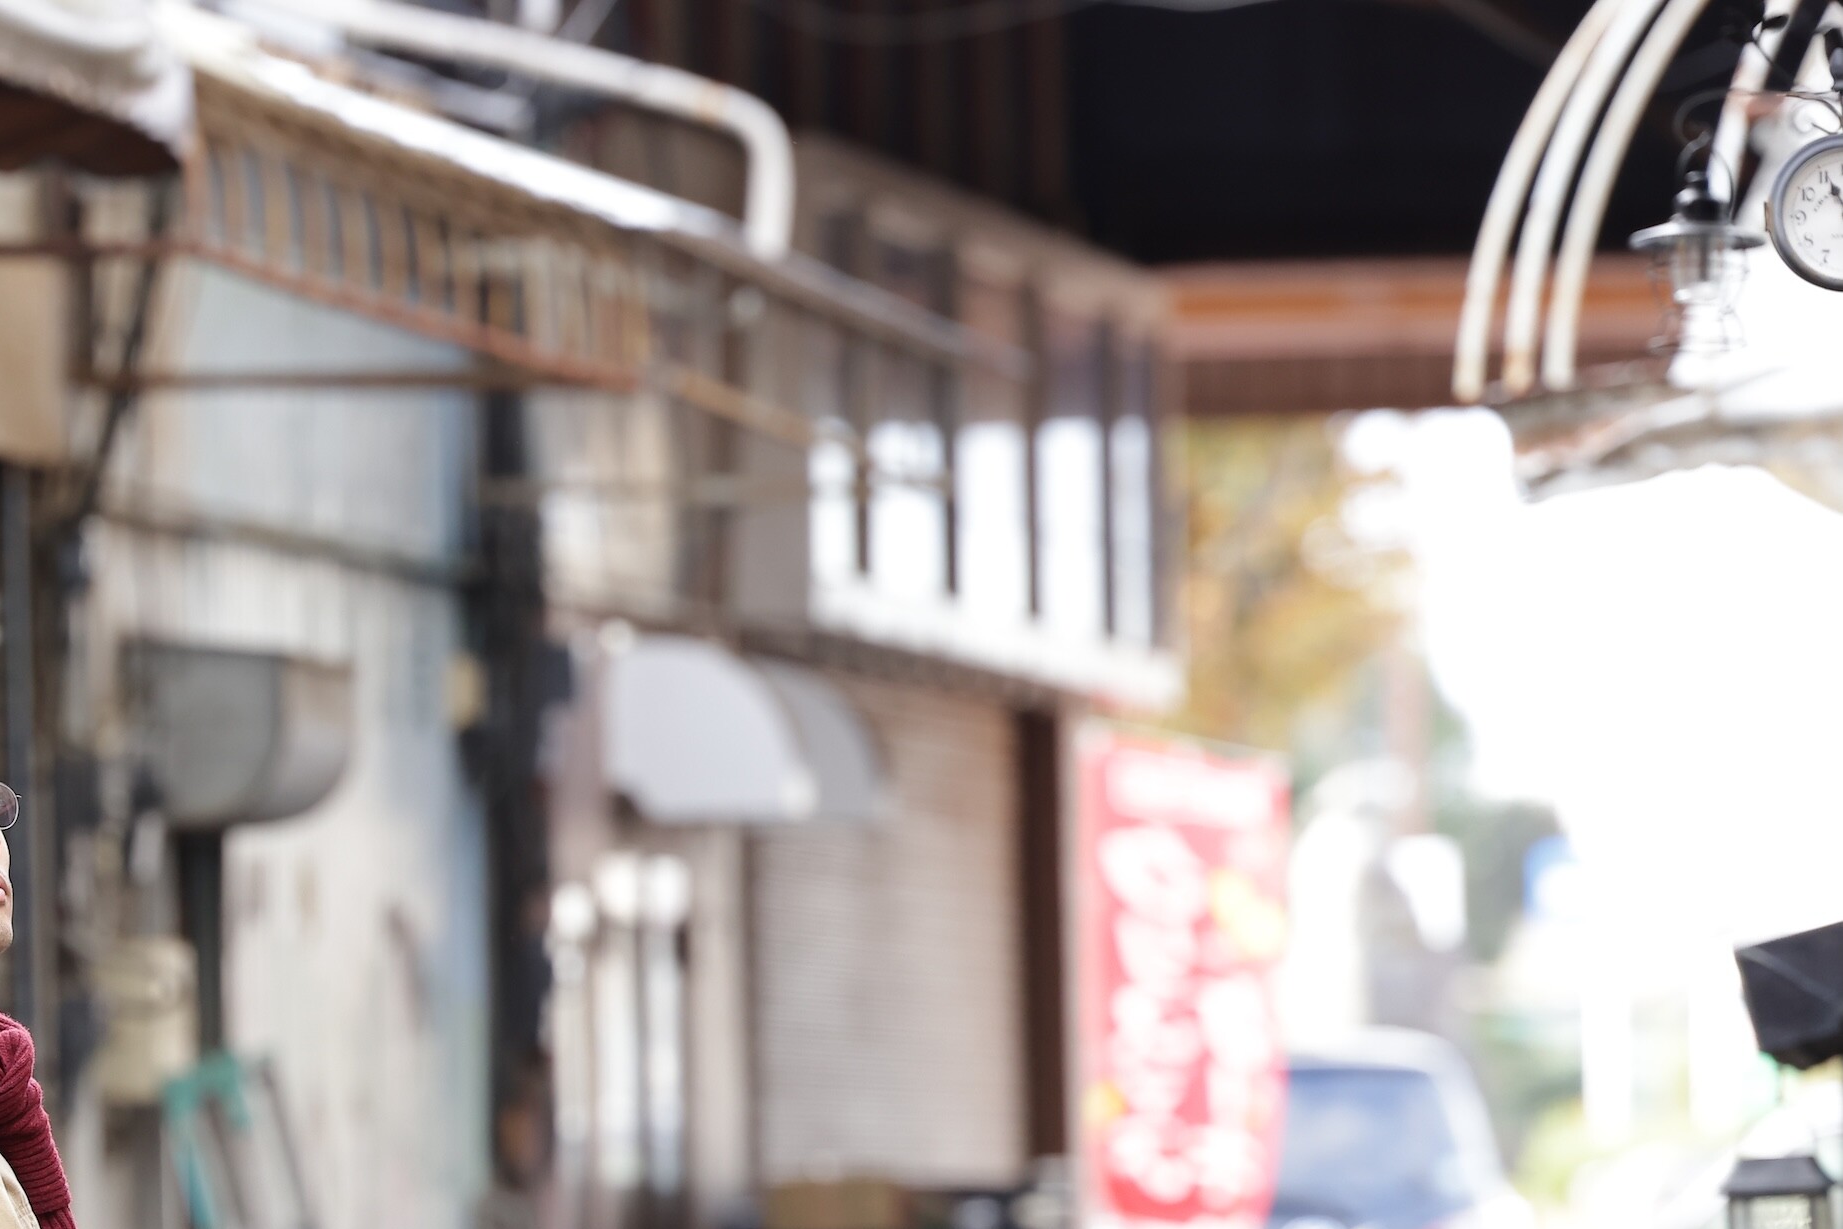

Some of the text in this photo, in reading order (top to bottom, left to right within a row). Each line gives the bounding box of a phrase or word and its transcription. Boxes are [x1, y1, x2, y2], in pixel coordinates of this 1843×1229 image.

[1819, 170, 1828, 184] 11
[1802, 187, 1815, 201] 10
[1795, 210, 1807, 225] 9
[1803, 232, 1814, 248] 8
[1821, 249, 1831, 263] 7
